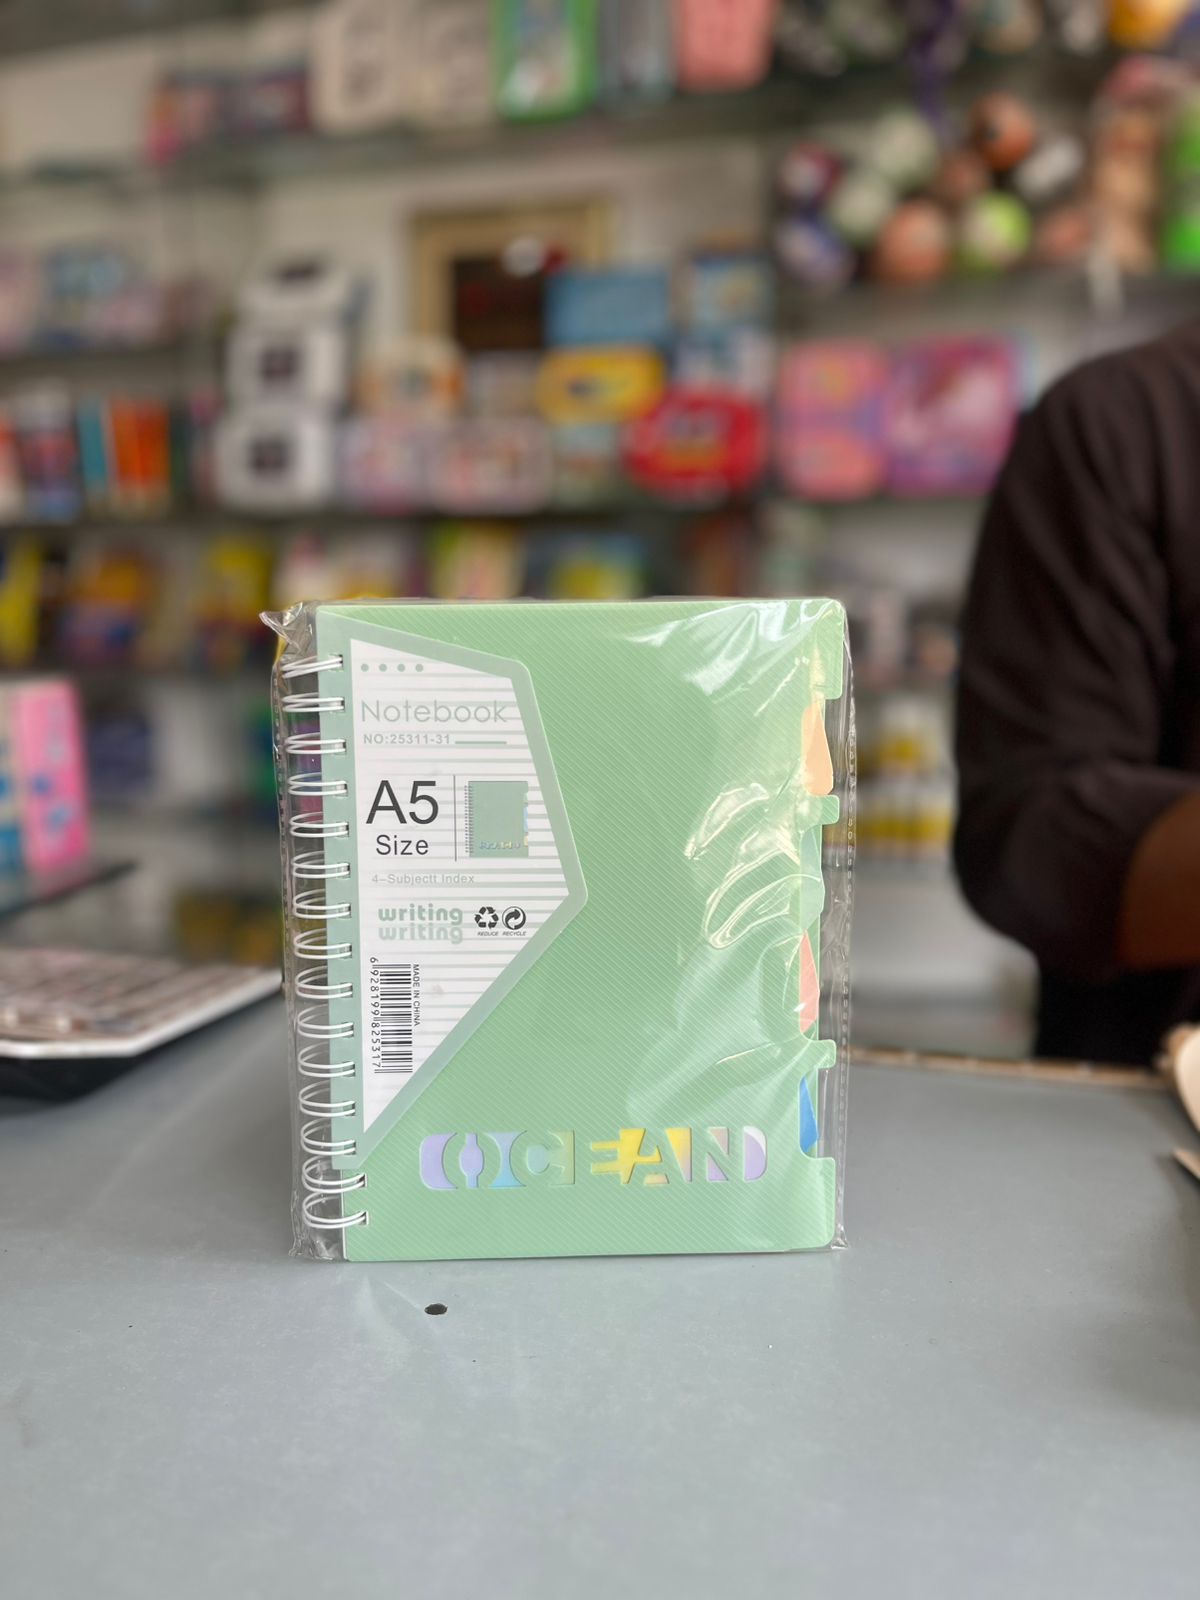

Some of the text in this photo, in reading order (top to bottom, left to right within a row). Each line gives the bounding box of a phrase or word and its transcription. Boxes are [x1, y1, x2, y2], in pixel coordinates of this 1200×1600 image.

[361, 699, 507, 723] Notebook
[363, 734, 451, 745] NO:25311-31
[365, 779, 439, 825] A5
[375, 834, 429, 856] Size
[441, 873, 475, 884] Index
[378, 903, 463, 926] writing
[378, 922, 464, 945] writing
[412, 964, 421, 1027] MADE IN CHINA
